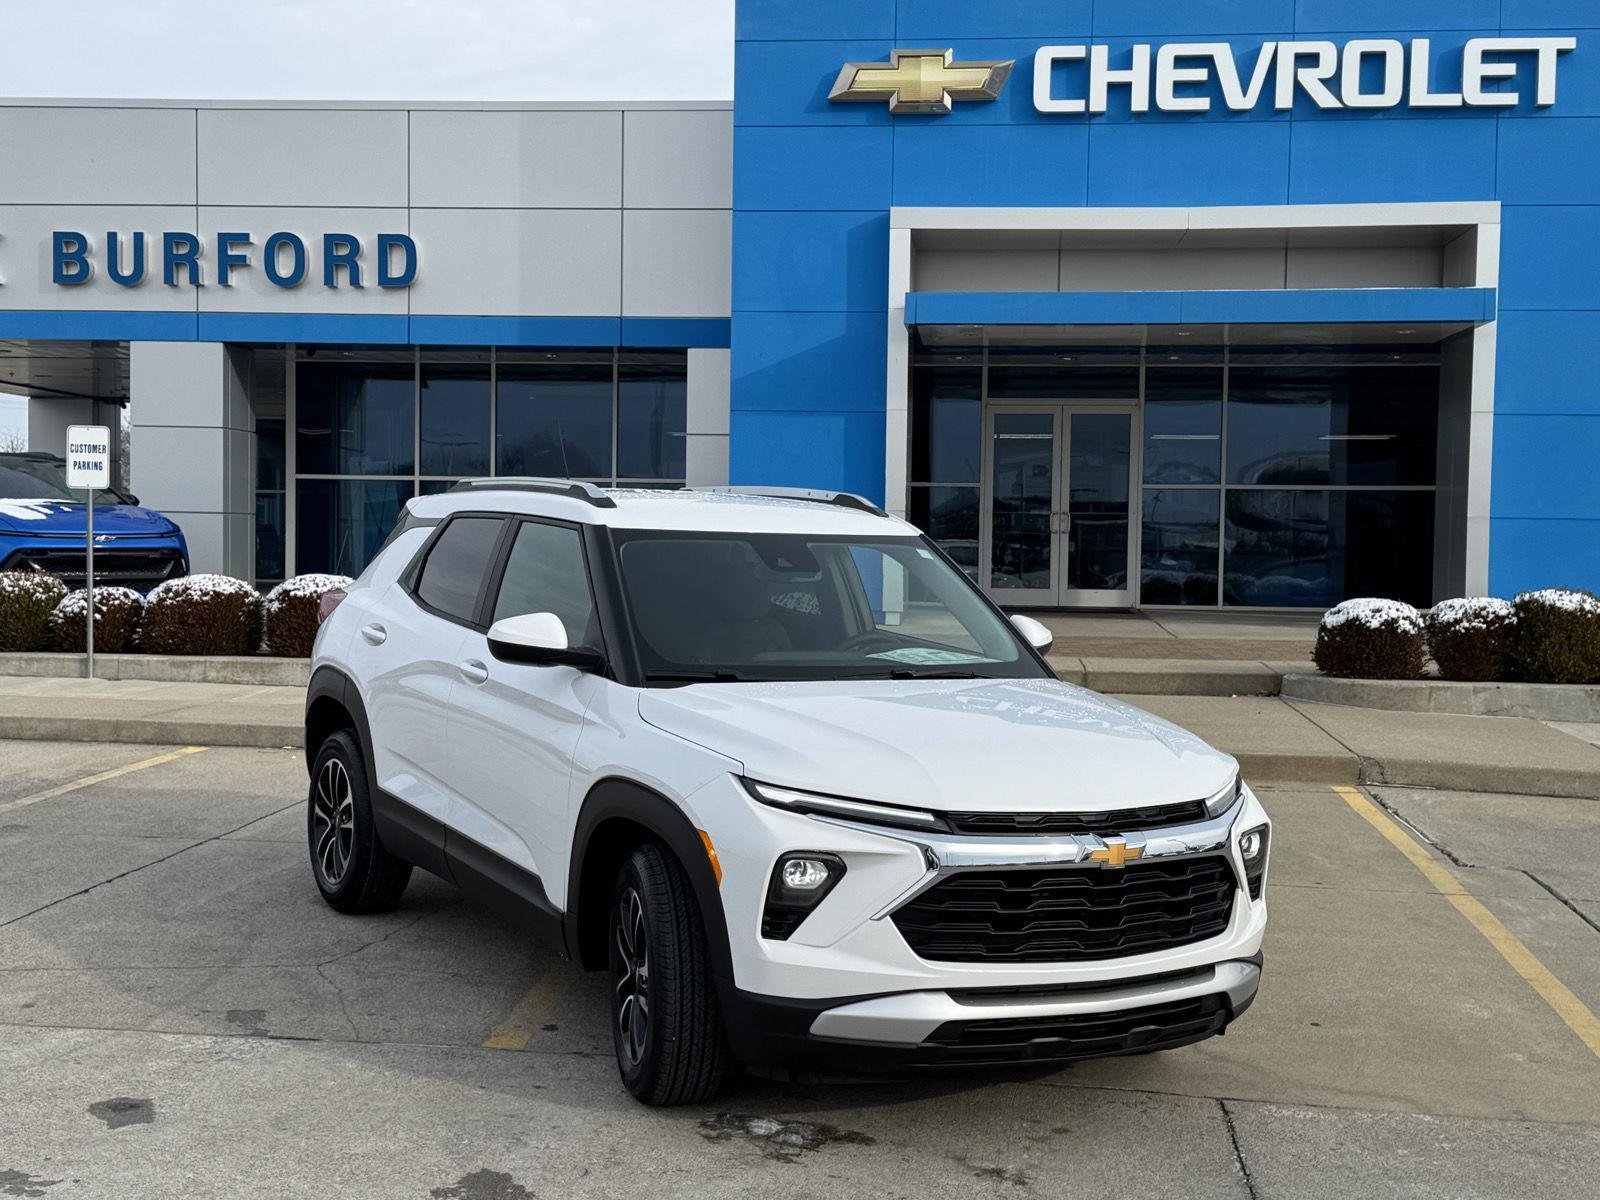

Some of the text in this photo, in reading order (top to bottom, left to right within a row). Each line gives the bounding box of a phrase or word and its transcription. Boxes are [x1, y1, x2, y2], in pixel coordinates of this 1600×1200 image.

[1033, 37, 1577, 113] CHEVROLET
[53, 230, 417, 287] BURFORD
[69, 443, 107, 454] CUSTOMER
[73, 460, 104, 471] PARKING
